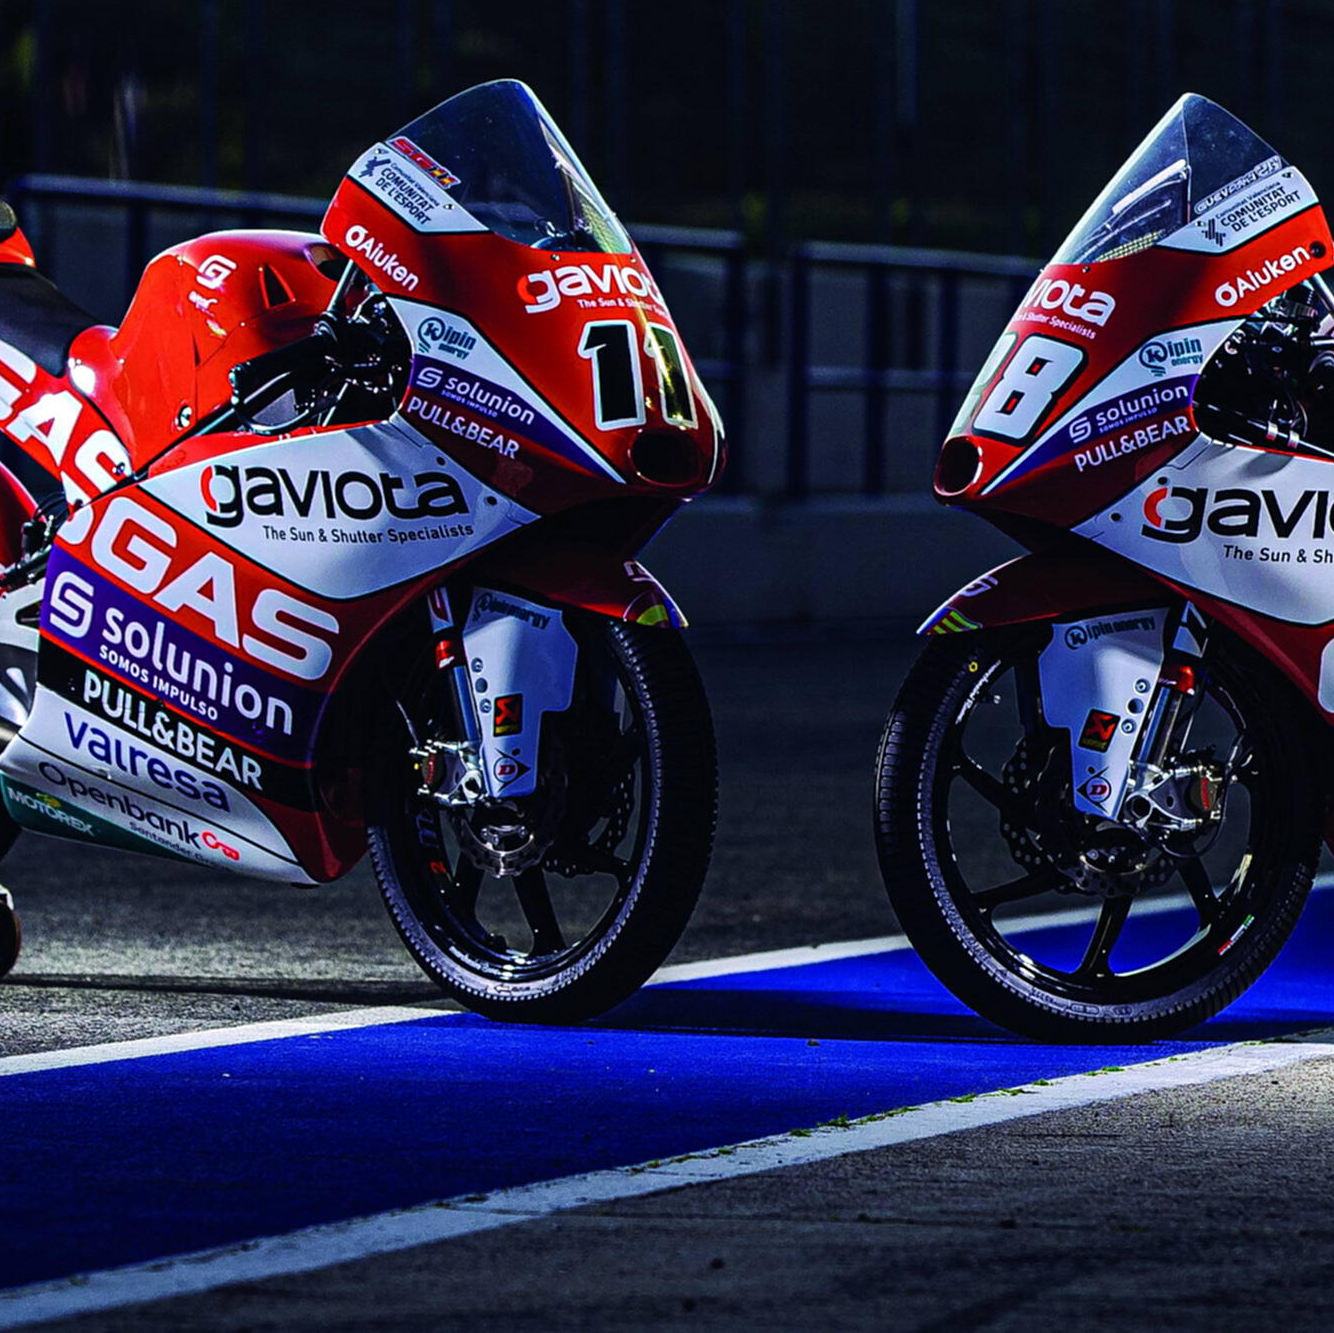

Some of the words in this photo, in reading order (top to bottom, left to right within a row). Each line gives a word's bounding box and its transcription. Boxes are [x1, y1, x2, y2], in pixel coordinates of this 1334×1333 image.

[375, 177, 391, 192] DE
[388, 186, 431, 225] L'ESPORT
[380, 167, 435, 212] COMUNITAT
[1220, 186, 1287, 227] COMUNITAT
[1231, 221, 1250, 232] DE
[1251, 190, 1301, 222] L'ESPORT
[357, 236, 419, 291] Aiuken
[1236, 246, 1311, 298] Aiuken
[578, 299, 597, 309] The
[599, 298, 616, 307] Sun
[1049, 315, 1097, 339] Specialists
[578, 319, 698, 432] 11
[445, 377, 535, 425] solunion
[1096, 386, 1189, 426] solunion
[407, 396, 520, 459] PULL&BEAR
[1074, 416, 1191, 472] PULL&BEAR
[200, 463, 469, 527] gaviota
[262, 525, 286, 541] The
[290, 527, 314, 542] Sun
[319, 530, 327, 542] &
[331, 528, 383, 543] Shutter
[388, 524, 474, 544] Specialists
[1223, 544, 1254, 561] The
[1259, 547, 1291, 563] Sun
[1297, 549, 1307, 563] &
[99, 644, 149, 683] SOMOS
[152, 675, 218, 720] IMPULSO
[102, 607, 293, 735] solunion
[84, 669, 263, 790] PULL&BEAR
[64, 711, 230, 812] valresa
[8, 787, 95, 836] MOTOREX
[38, 761, 202, 849] Openbank
